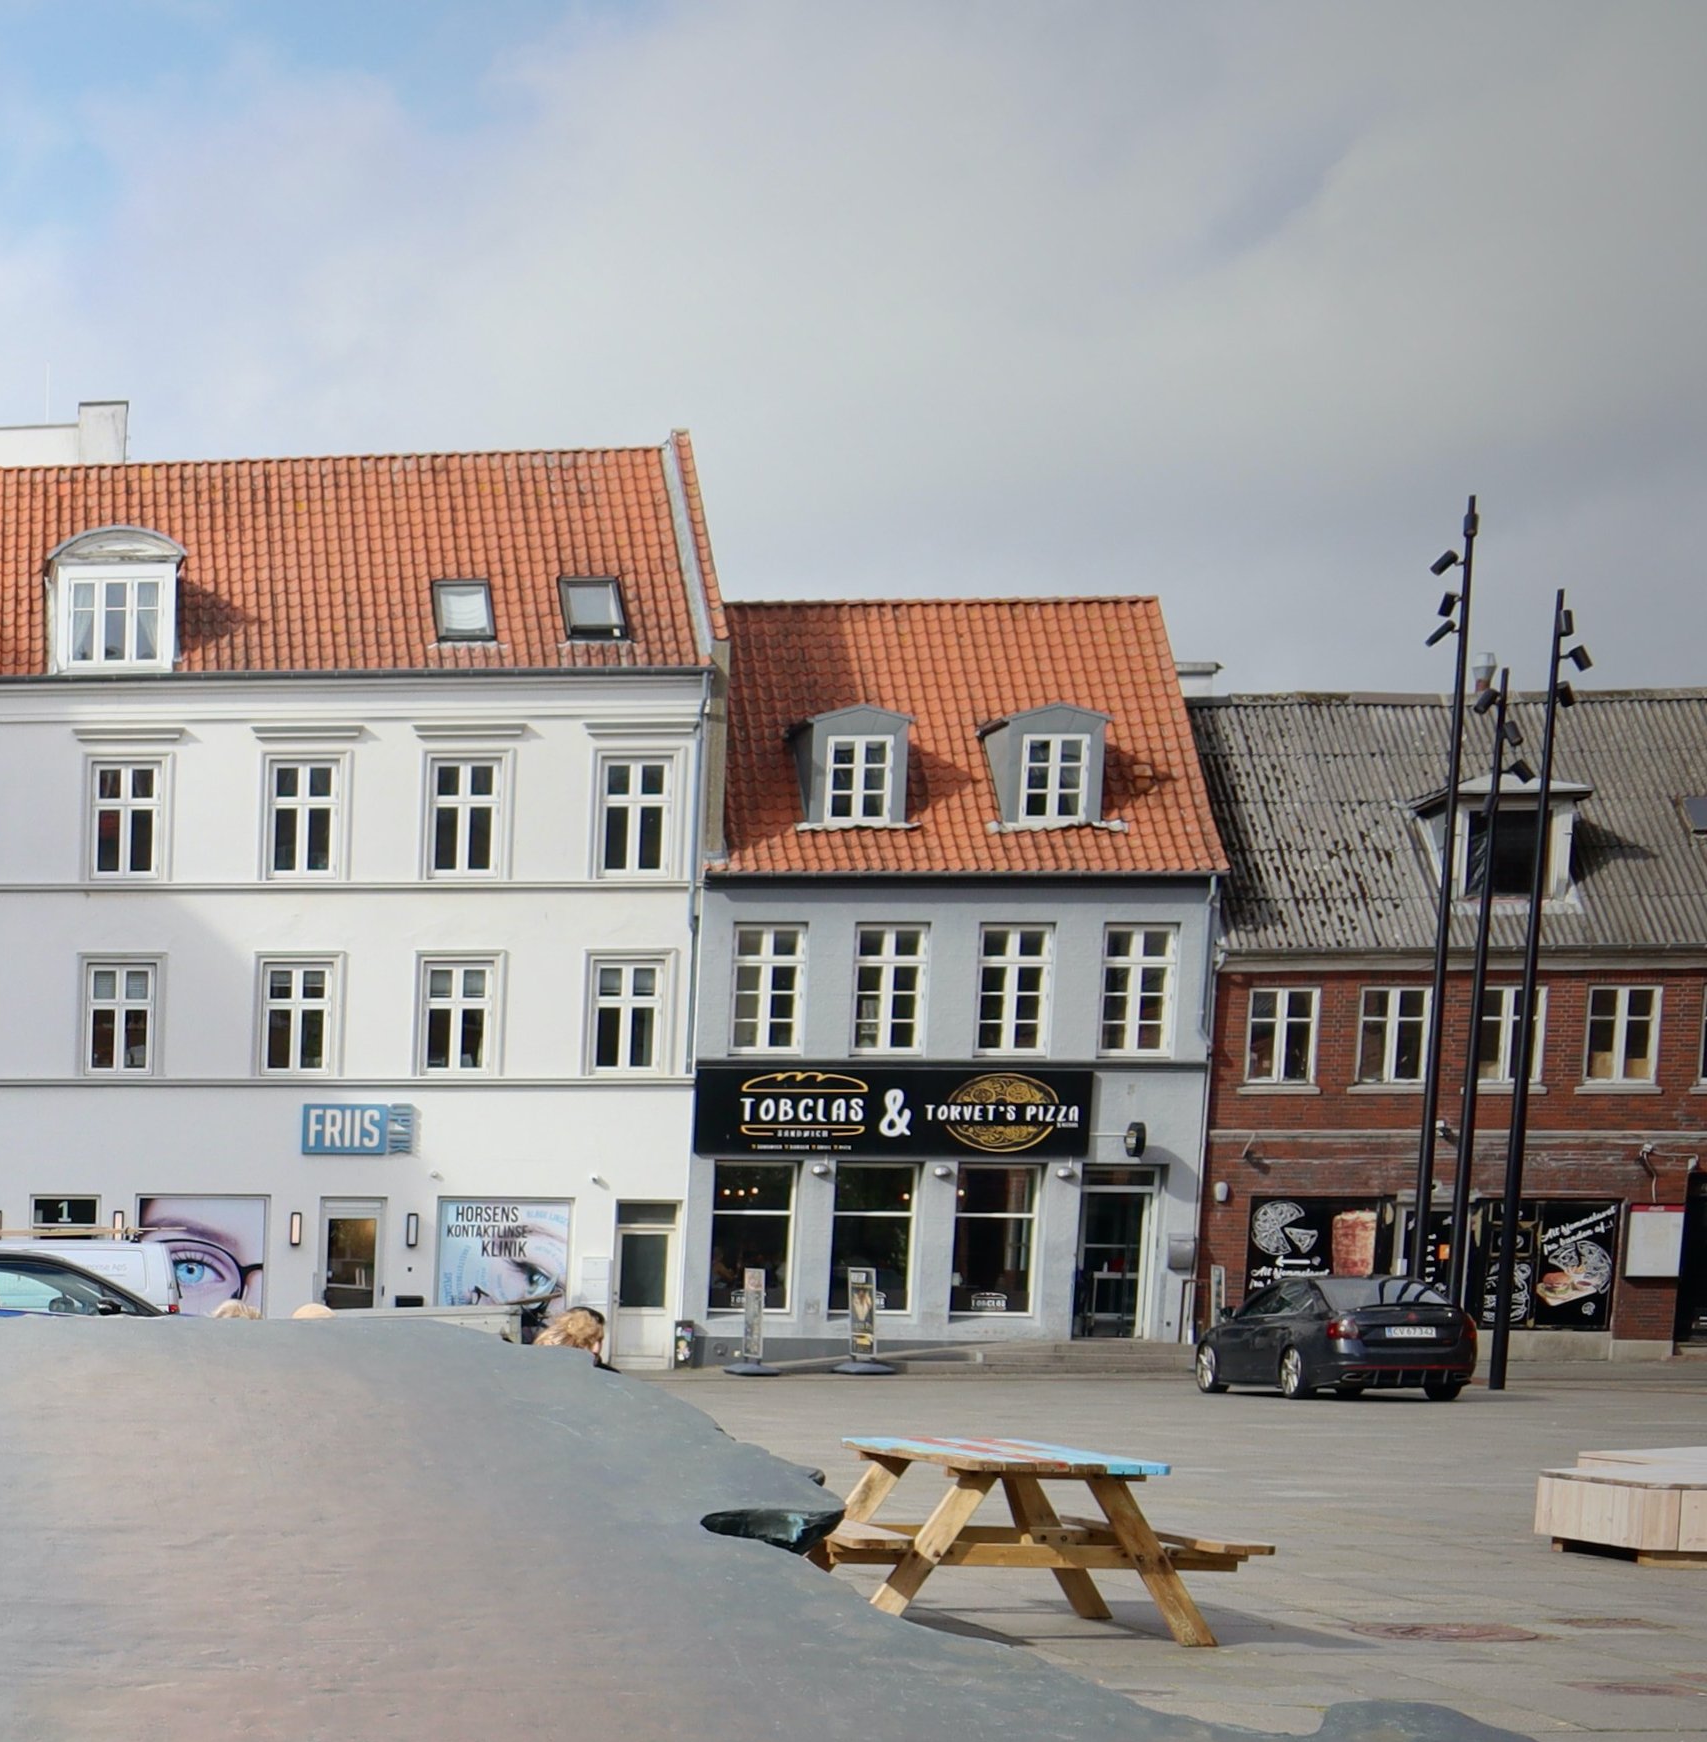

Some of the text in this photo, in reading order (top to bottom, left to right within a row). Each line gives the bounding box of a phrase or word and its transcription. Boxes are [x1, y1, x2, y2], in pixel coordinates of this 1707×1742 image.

[740, 1088, 1079, 1137] TOBCLAS & TORVET'S PIZZA
[309, 1109, 380, 1147] FRIIS
[777, 1130, 829, 1138] SANDWICH
[58, 1201, 72, 1222] 1
[455, 1206, 519, 1222] HORSENS
[481, 1241, 527, 1257] KLINIK
